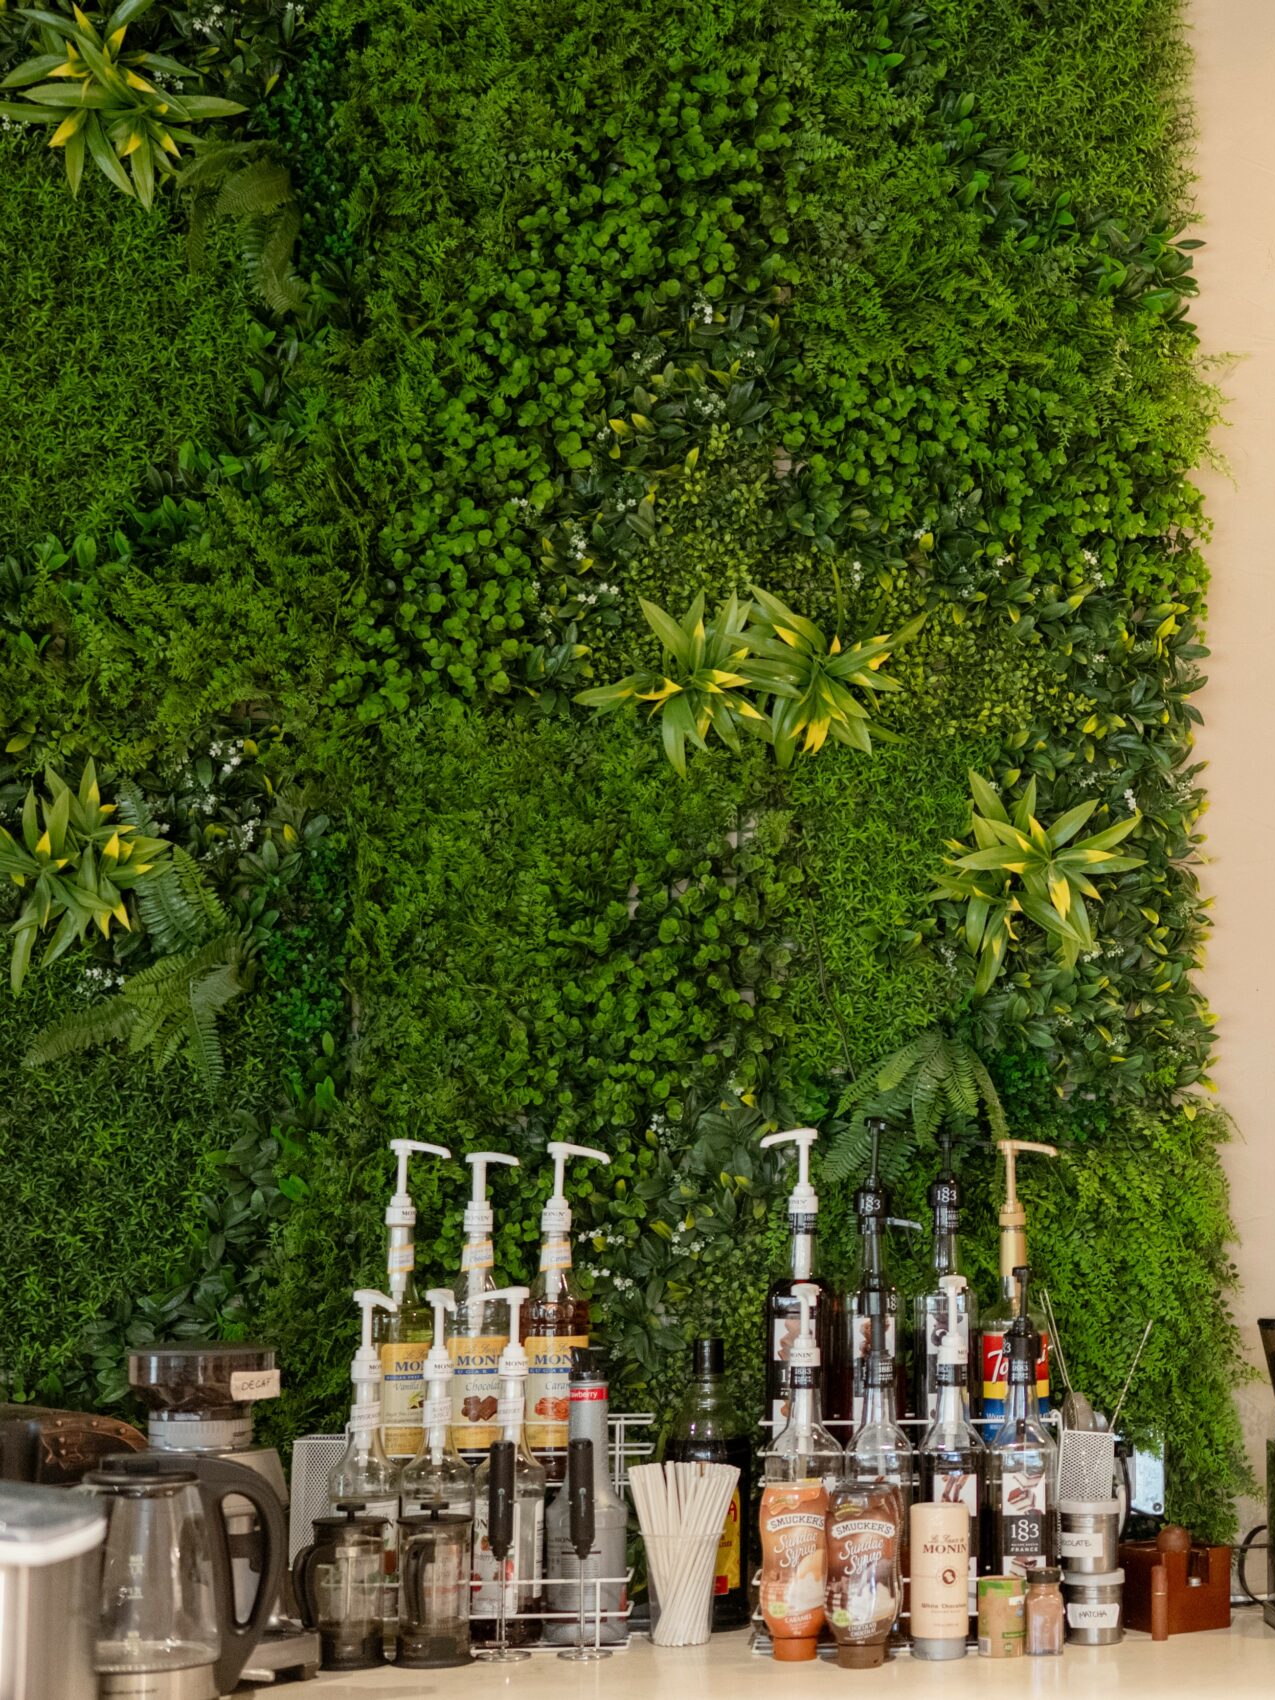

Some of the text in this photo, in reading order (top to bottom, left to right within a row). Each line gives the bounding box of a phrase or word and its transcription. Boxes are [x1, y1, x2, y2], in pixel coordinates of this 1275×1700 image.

[770, 1515, 824, 1529] SMUCKER'S
[836, 1522, 892, 1536] SMUCKER'S
[773, 1531, 818, 1553] Sundae
[839, 1538, 884, 1560] Sundae
[922, 1544, 967, 1554] MONIN
[780, 1543, 817, 1567] Syrup
[844, 1550, 882, 1575] Syrup
